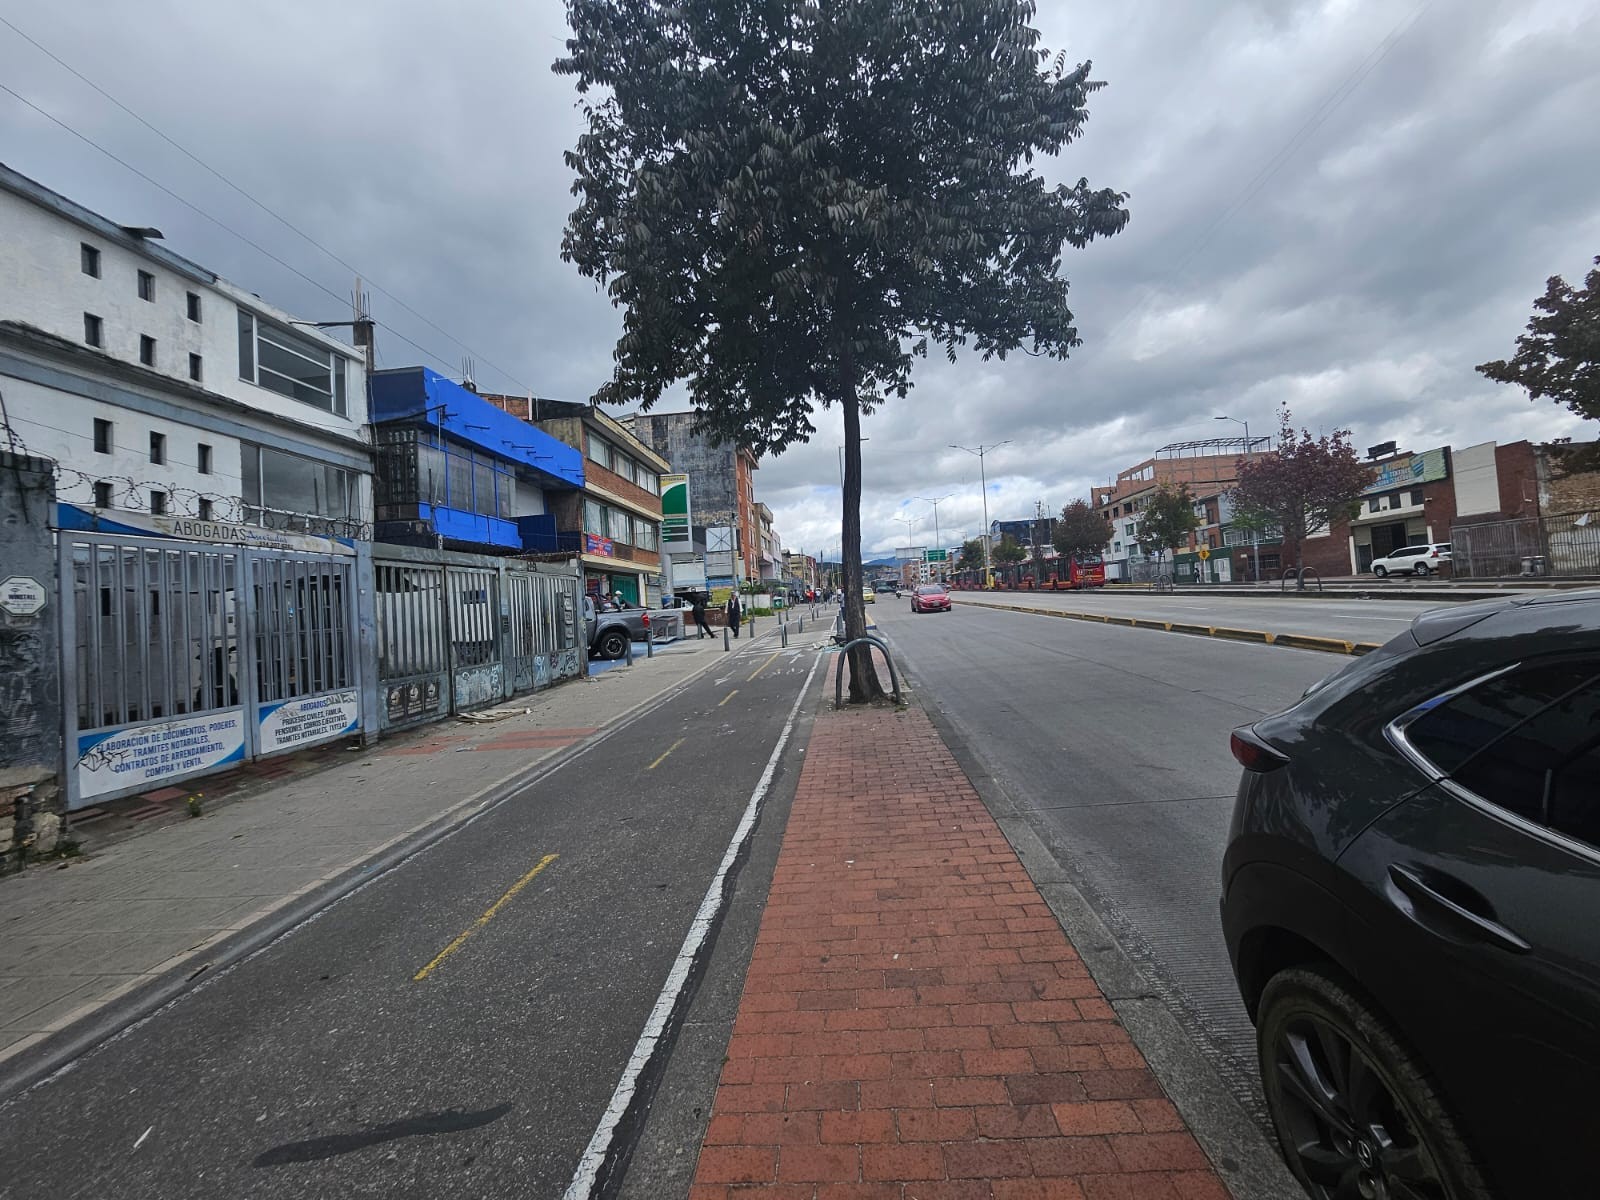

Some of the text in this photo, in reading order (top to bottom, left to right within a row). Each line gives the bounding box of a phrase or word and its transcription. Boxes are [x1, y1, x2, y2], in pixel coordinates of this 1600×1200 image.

[174, 521, 246, 540] ABOGADAS
[152, 733, 160, 742] DE
[134, 744, 170, 757] TRAMITES
[115, 757, 158, 773] CONTRATOS
[161, 754, 169, 763] DE
[146, 764, 174, 778] COMPRA
[176, 762, 181, 770] Y
